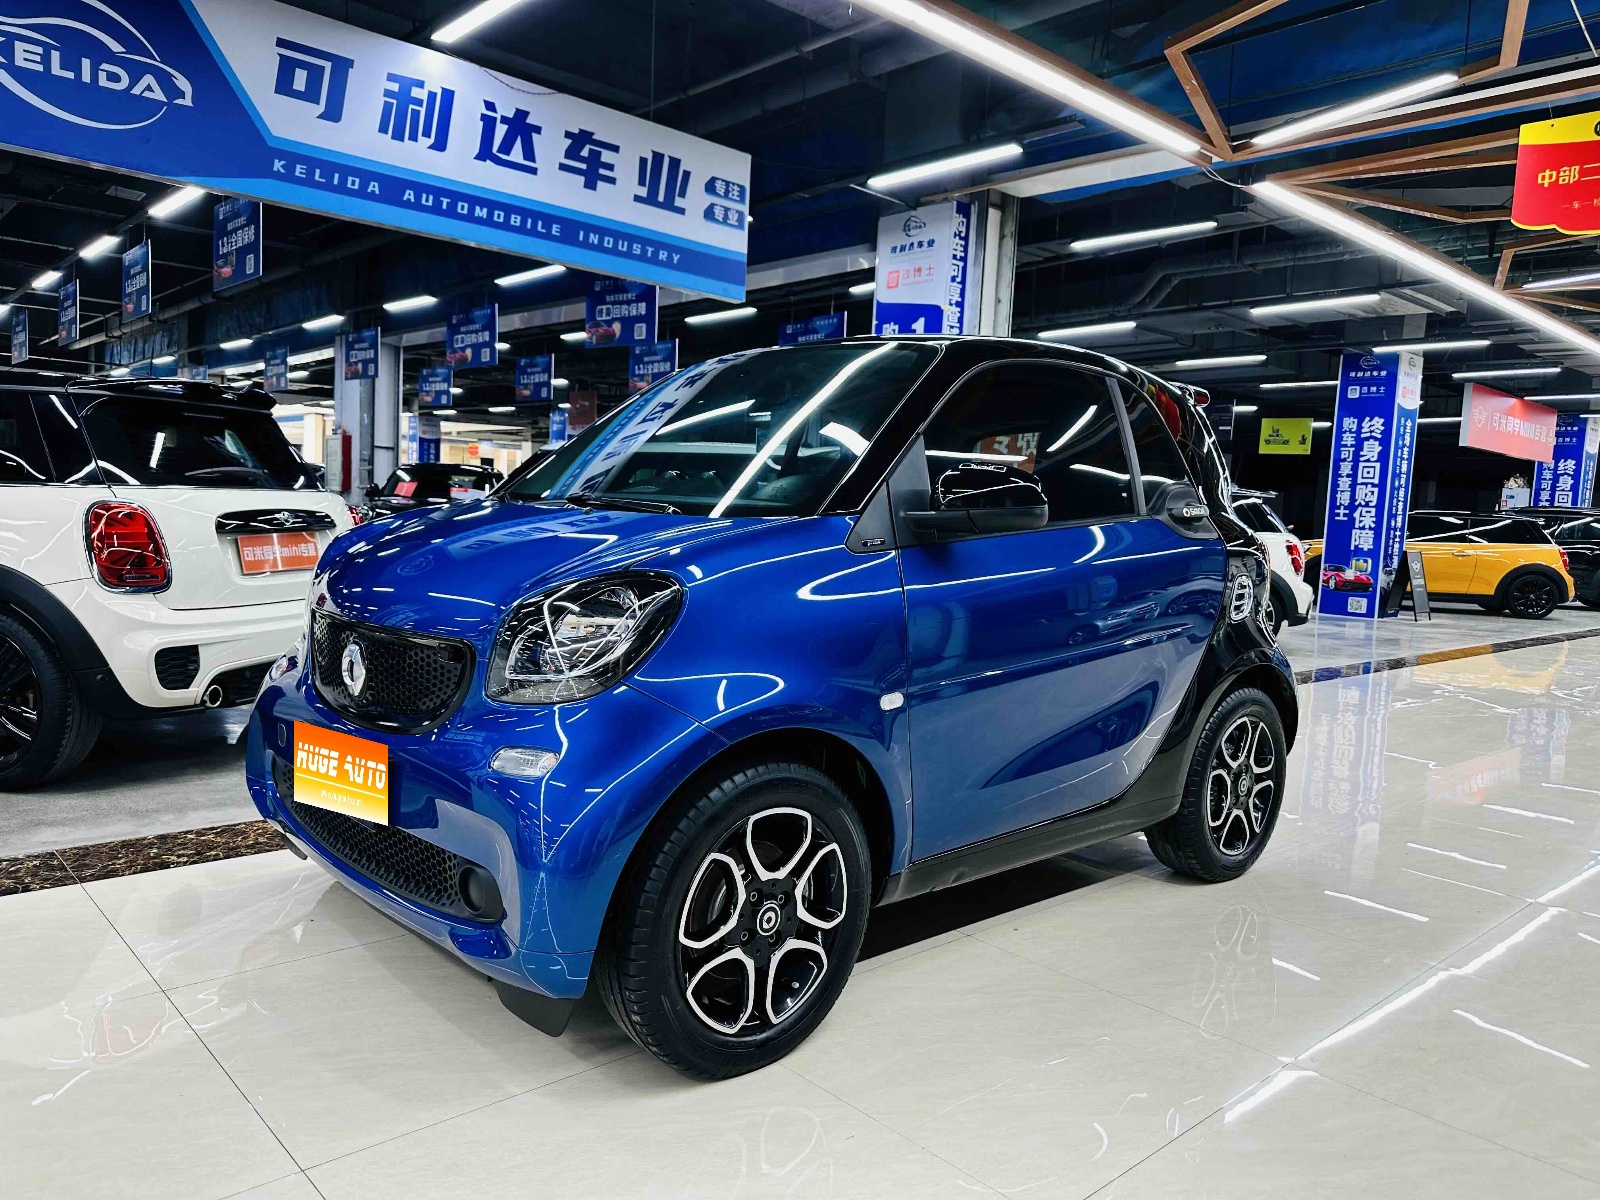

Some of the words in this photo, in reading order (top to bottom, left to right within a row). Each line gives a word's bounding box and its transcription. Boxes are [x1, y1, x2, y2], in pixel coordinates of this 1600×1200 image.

[0, 37, 168, 103] ELIDA
[273, 37, 692, 216] 可利达车业
[273, 158, 381, 195] KELIDA
[403, 189, 562, 237] AUTOMOBILE
[579, 230, 682, 265] INDUSTRY
[712, 205, 739, 226] 专业
[714, 179, 741, 201] 专注
[1334, 416, 1358, 521] 购车可享查博士
[1350, 416, 1385, 552] 终身回购保障
[1554, 458, 1577, 507] 终身回
